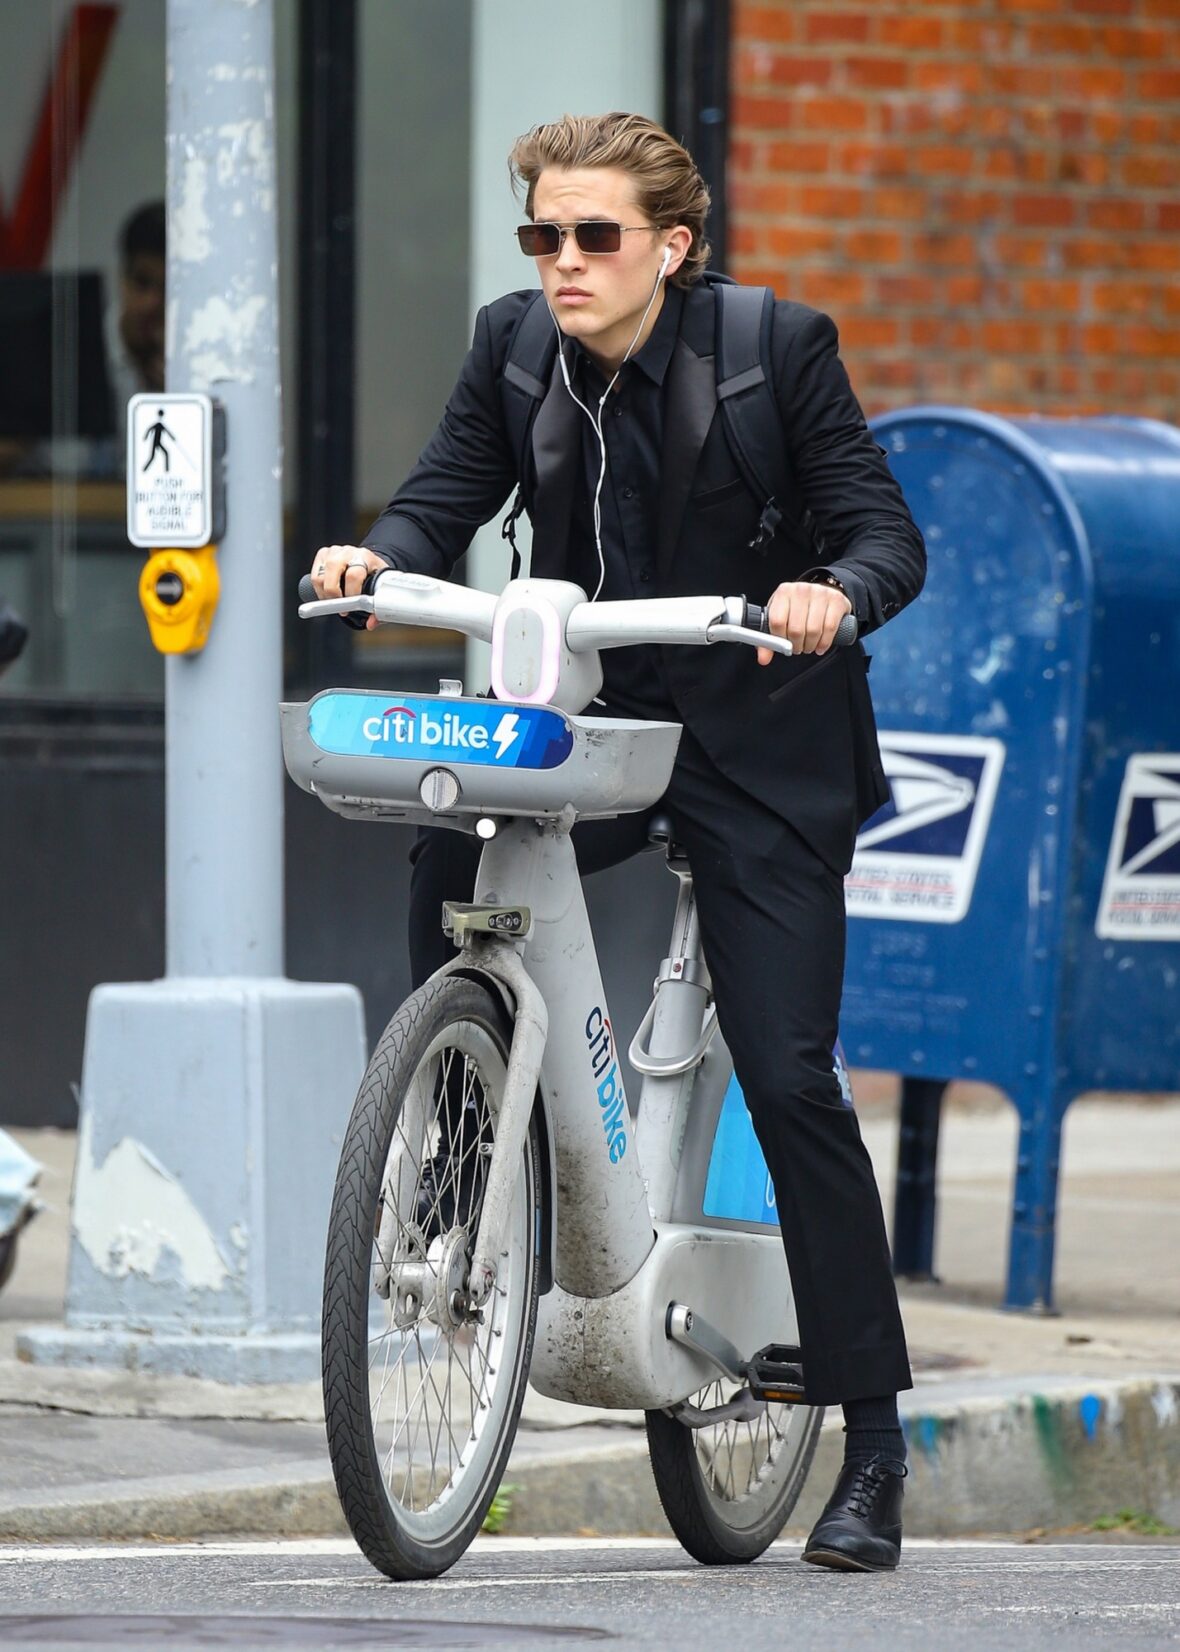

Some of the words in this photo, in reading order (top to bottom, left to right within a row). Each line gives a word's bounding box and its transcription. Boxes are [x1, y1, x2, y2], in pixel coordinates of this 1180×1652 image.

[362, 707, 416, 743] citi
[420, 713, 488, 749] bike
[586, 1006, 613, 1078] citi
[597, 1062, 627, 1164] bike
